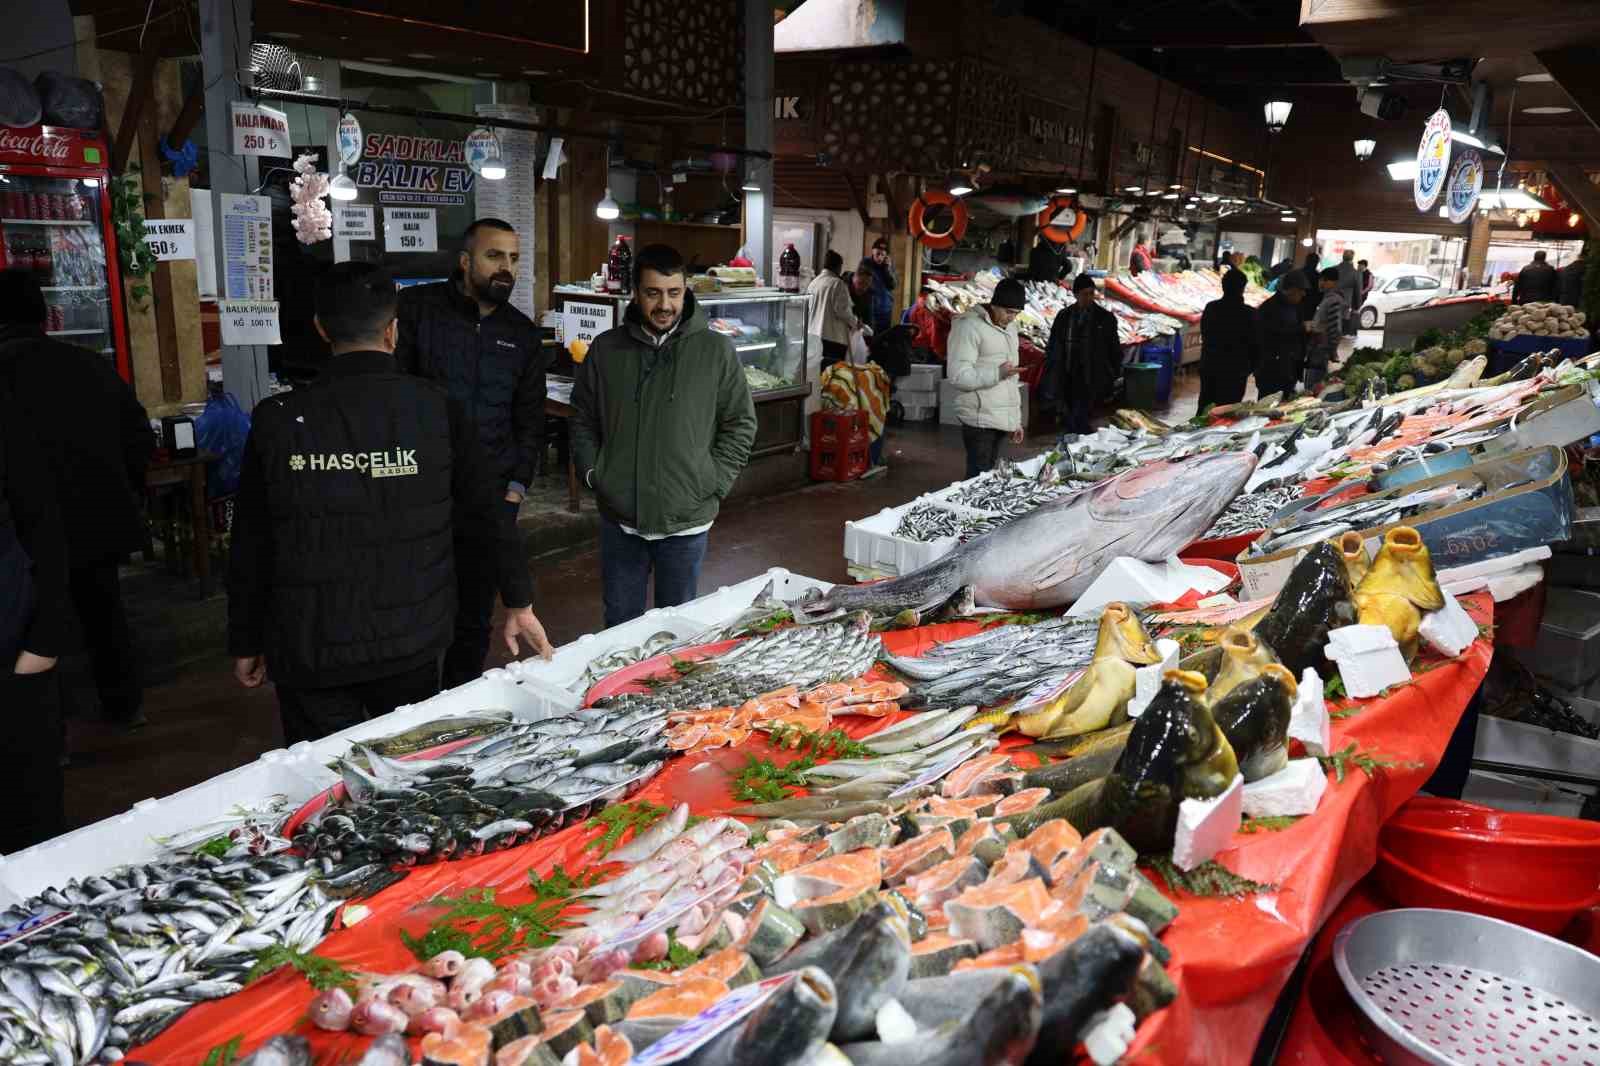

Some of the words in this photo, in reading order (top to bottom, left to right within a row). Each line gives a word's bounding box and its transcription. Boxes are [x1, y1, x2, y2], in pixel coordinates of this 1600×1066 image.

[234, 112, 286, 132] KALAMAR
[244, 135, 265, 149] 250
[356, 161, 439, 192] BALIK
[158, 224, 185, 234] EKMEK
[400, 235, 416, 247] 150
[226, 305, 249, 313] BALIK
[251, 319, 264, 327] 100
[310, 446, 417, 474] HASÇELİK
